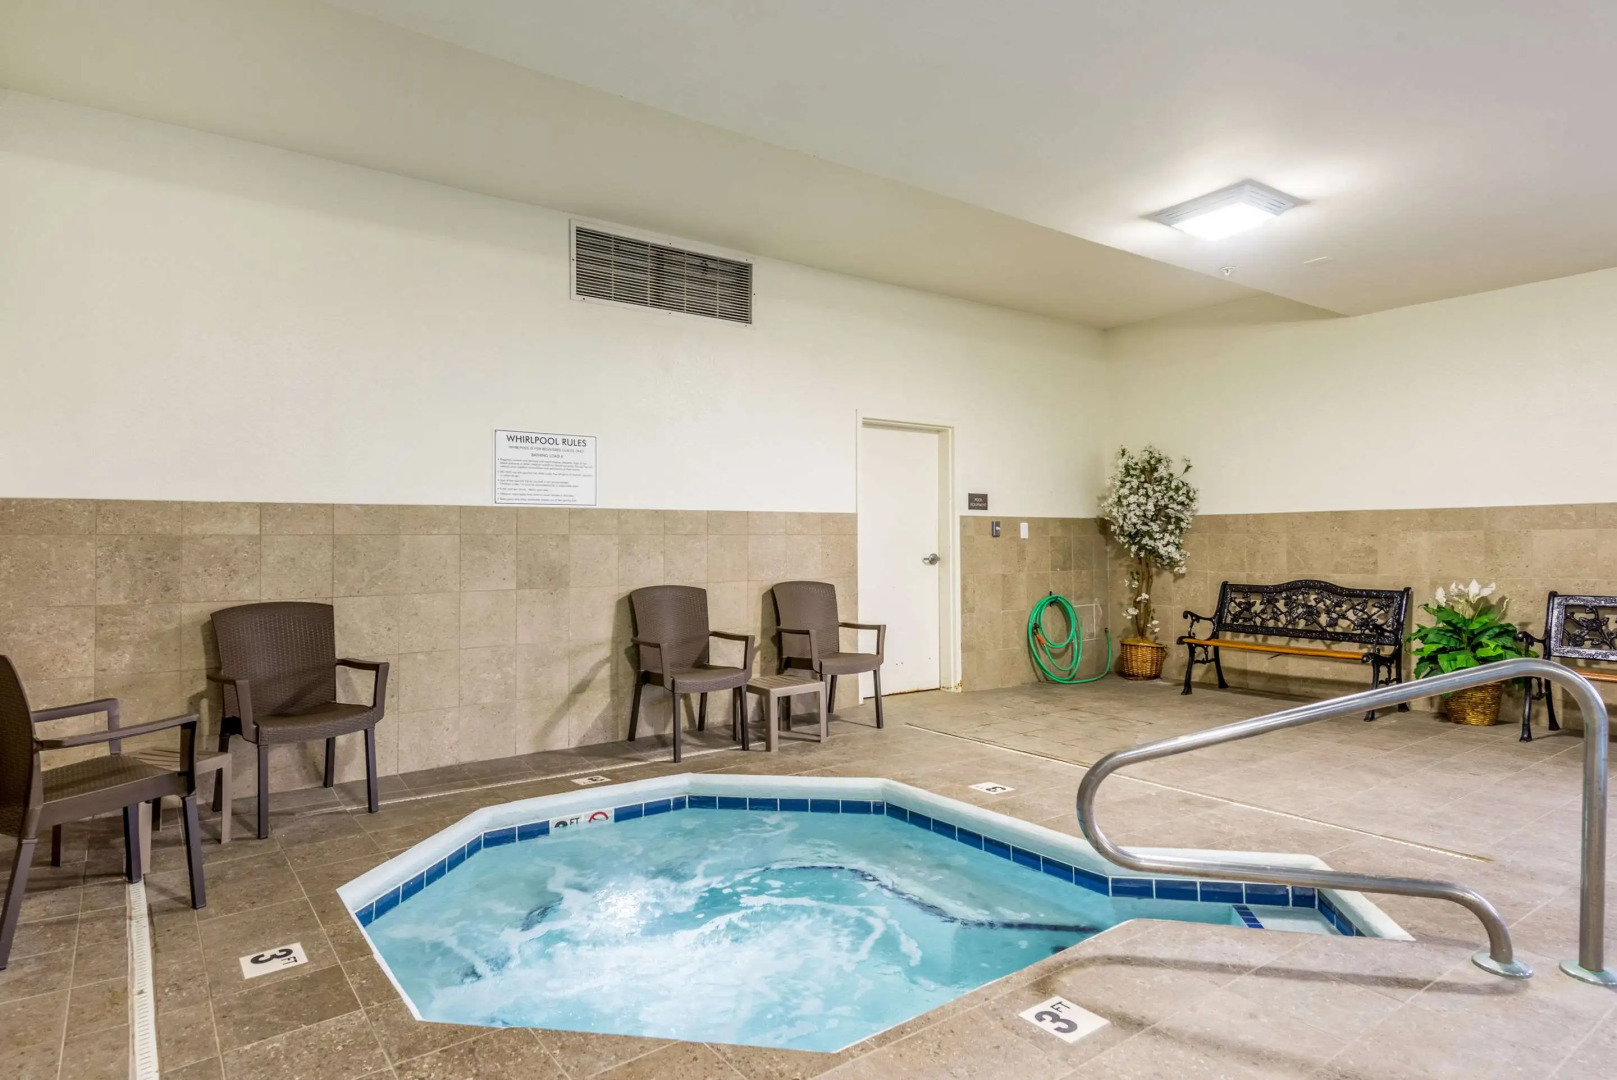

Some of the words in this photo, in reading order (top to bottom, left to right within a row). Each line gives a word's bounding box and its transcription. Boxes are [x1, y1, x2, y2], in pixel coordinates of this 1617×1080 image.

[506, 434, 559, 446] WHIRLPOOL
[562, 438, 587, 447] RULES
[569, 817, 579, 826] FT
[250, 948, 293, 965] 3
[281, 956, 298, 965] FT
[1050, 1001, 1071, 1013] FT
[1034, 1010, 1078, 1034] 3
